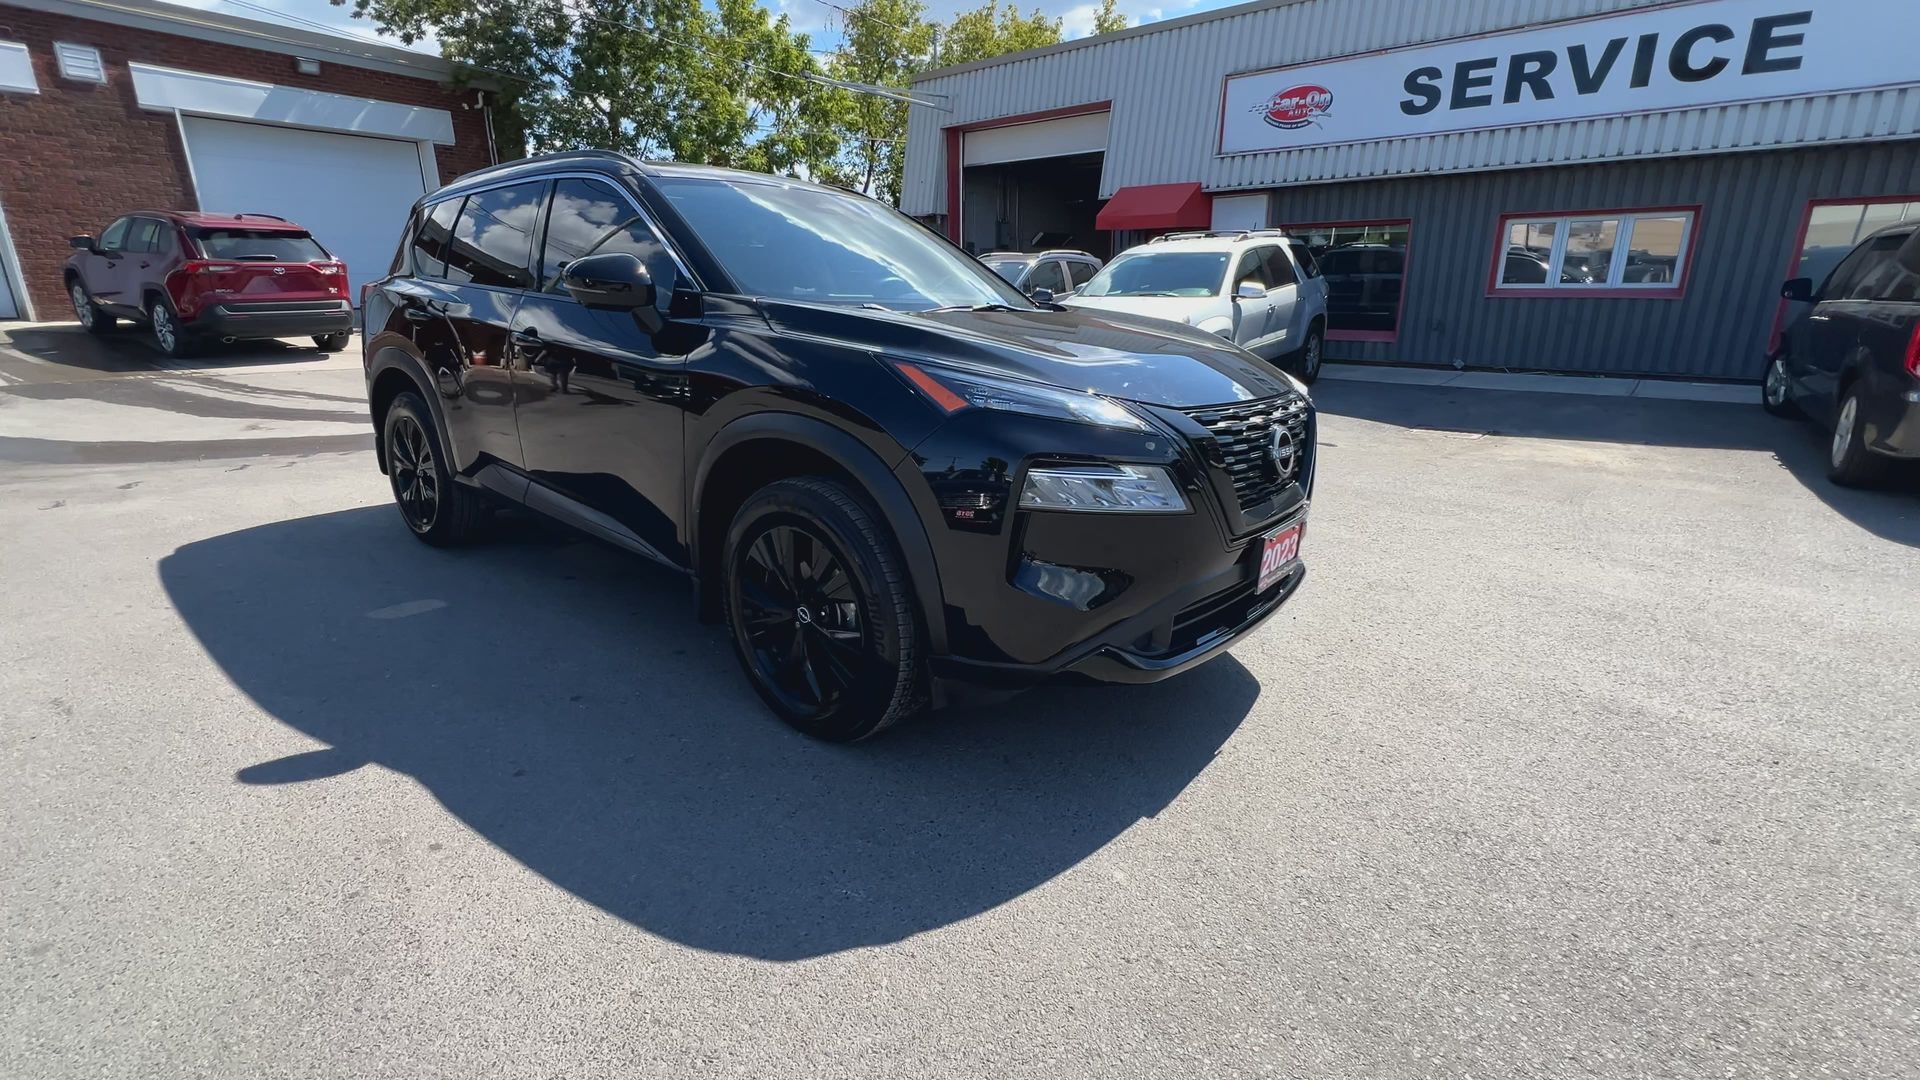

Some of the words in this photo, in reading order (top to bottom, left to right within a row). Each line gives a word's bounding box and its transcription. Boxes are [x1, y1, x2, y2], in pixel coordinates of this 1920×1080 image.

[1400, 10, 1813, 116] SERVICE
[1269, 91, 1331, 111] Car-On
[1260, 533, 1299, 578] 2023
